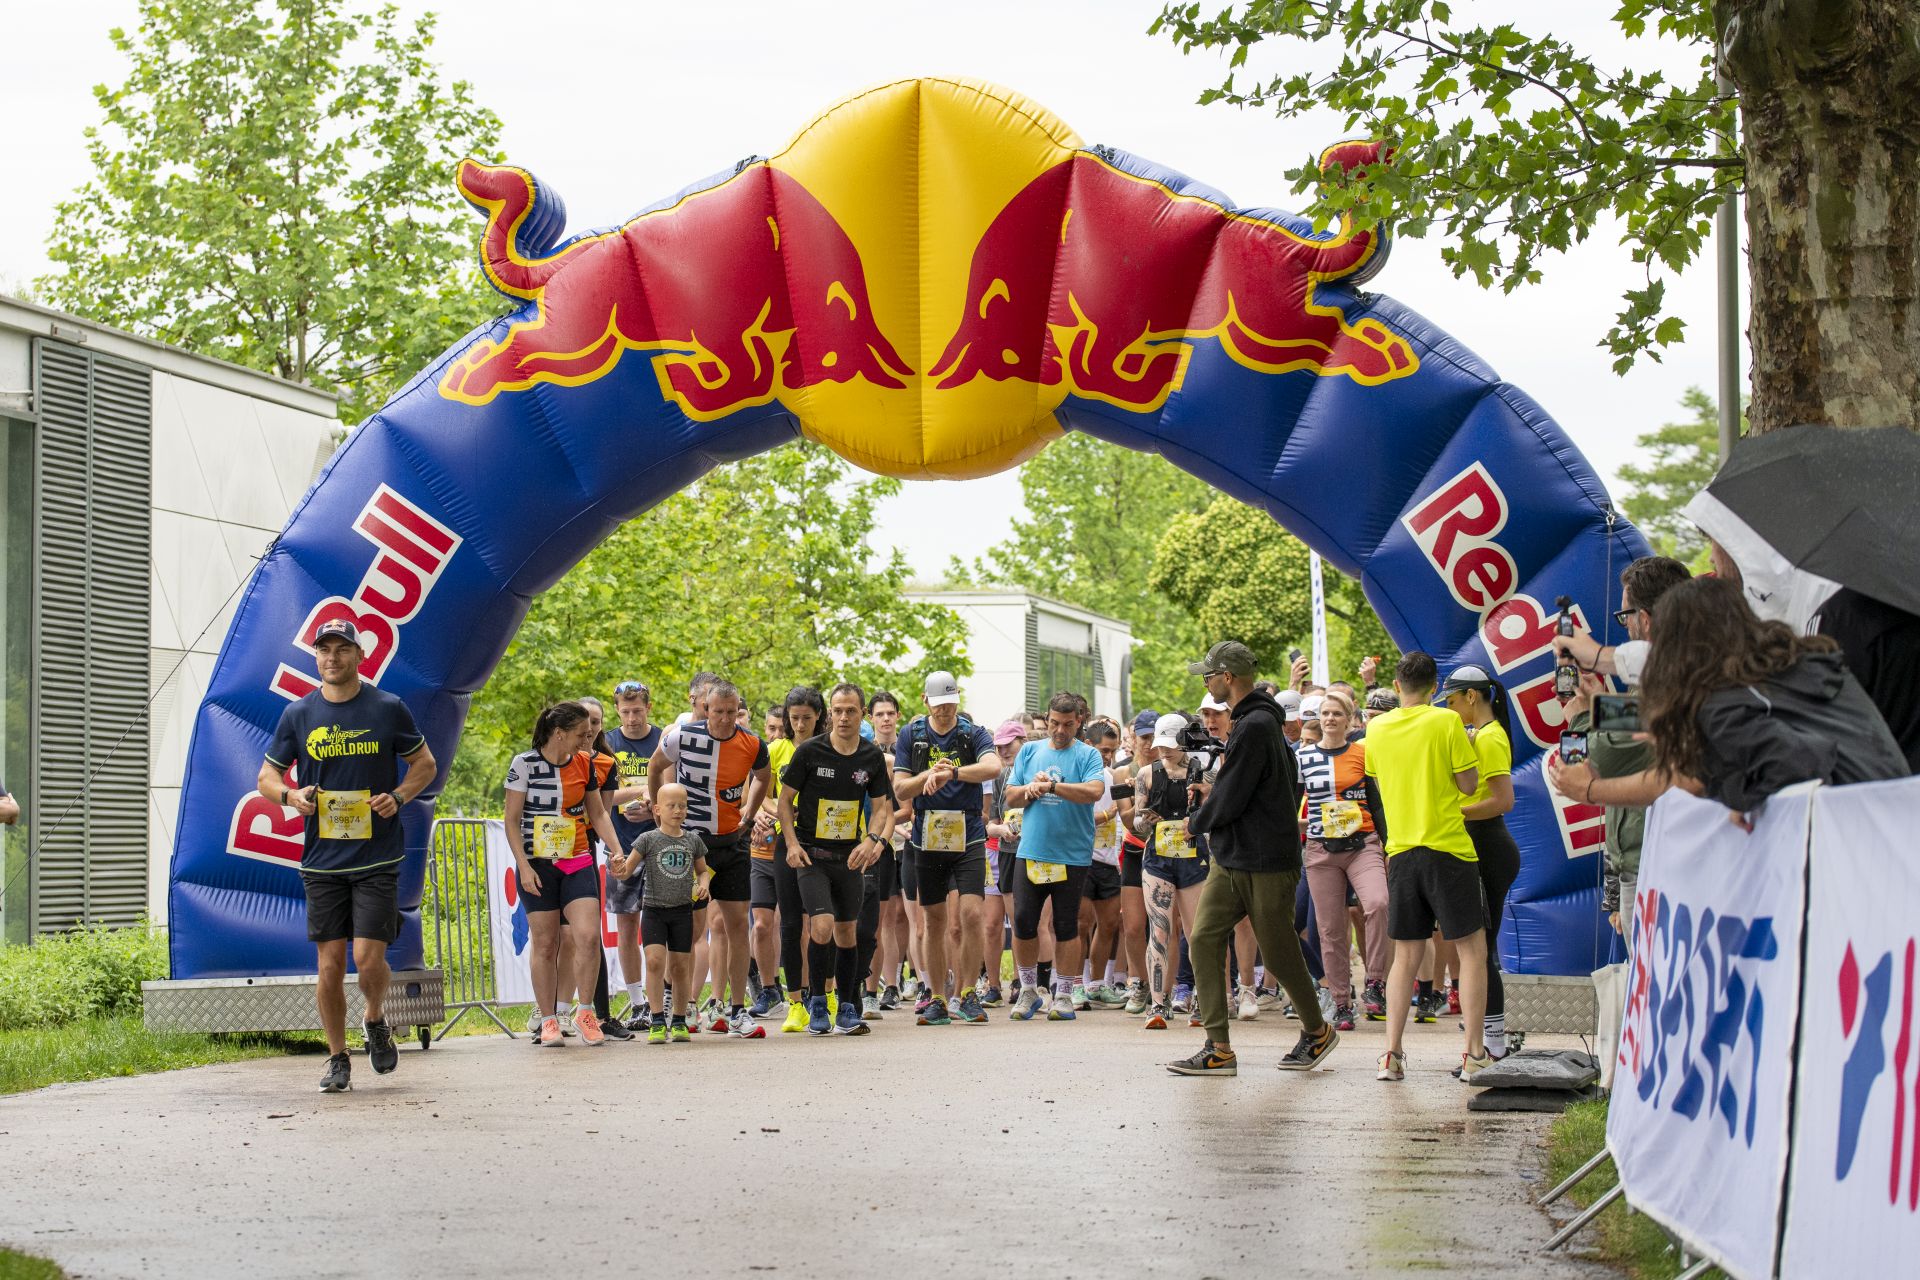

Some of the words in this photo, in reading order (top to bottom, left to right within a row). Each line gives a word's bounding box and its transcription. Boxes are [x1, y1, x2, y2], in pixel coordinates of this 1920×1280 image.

[297, 487, 459, 683] Bull
[1405, 465, 1586, 670] Red
[317, 742, 356, 758] WORLD
[356, 741, 379, 755] RUN
[329, 815, 361, 824] 189874
